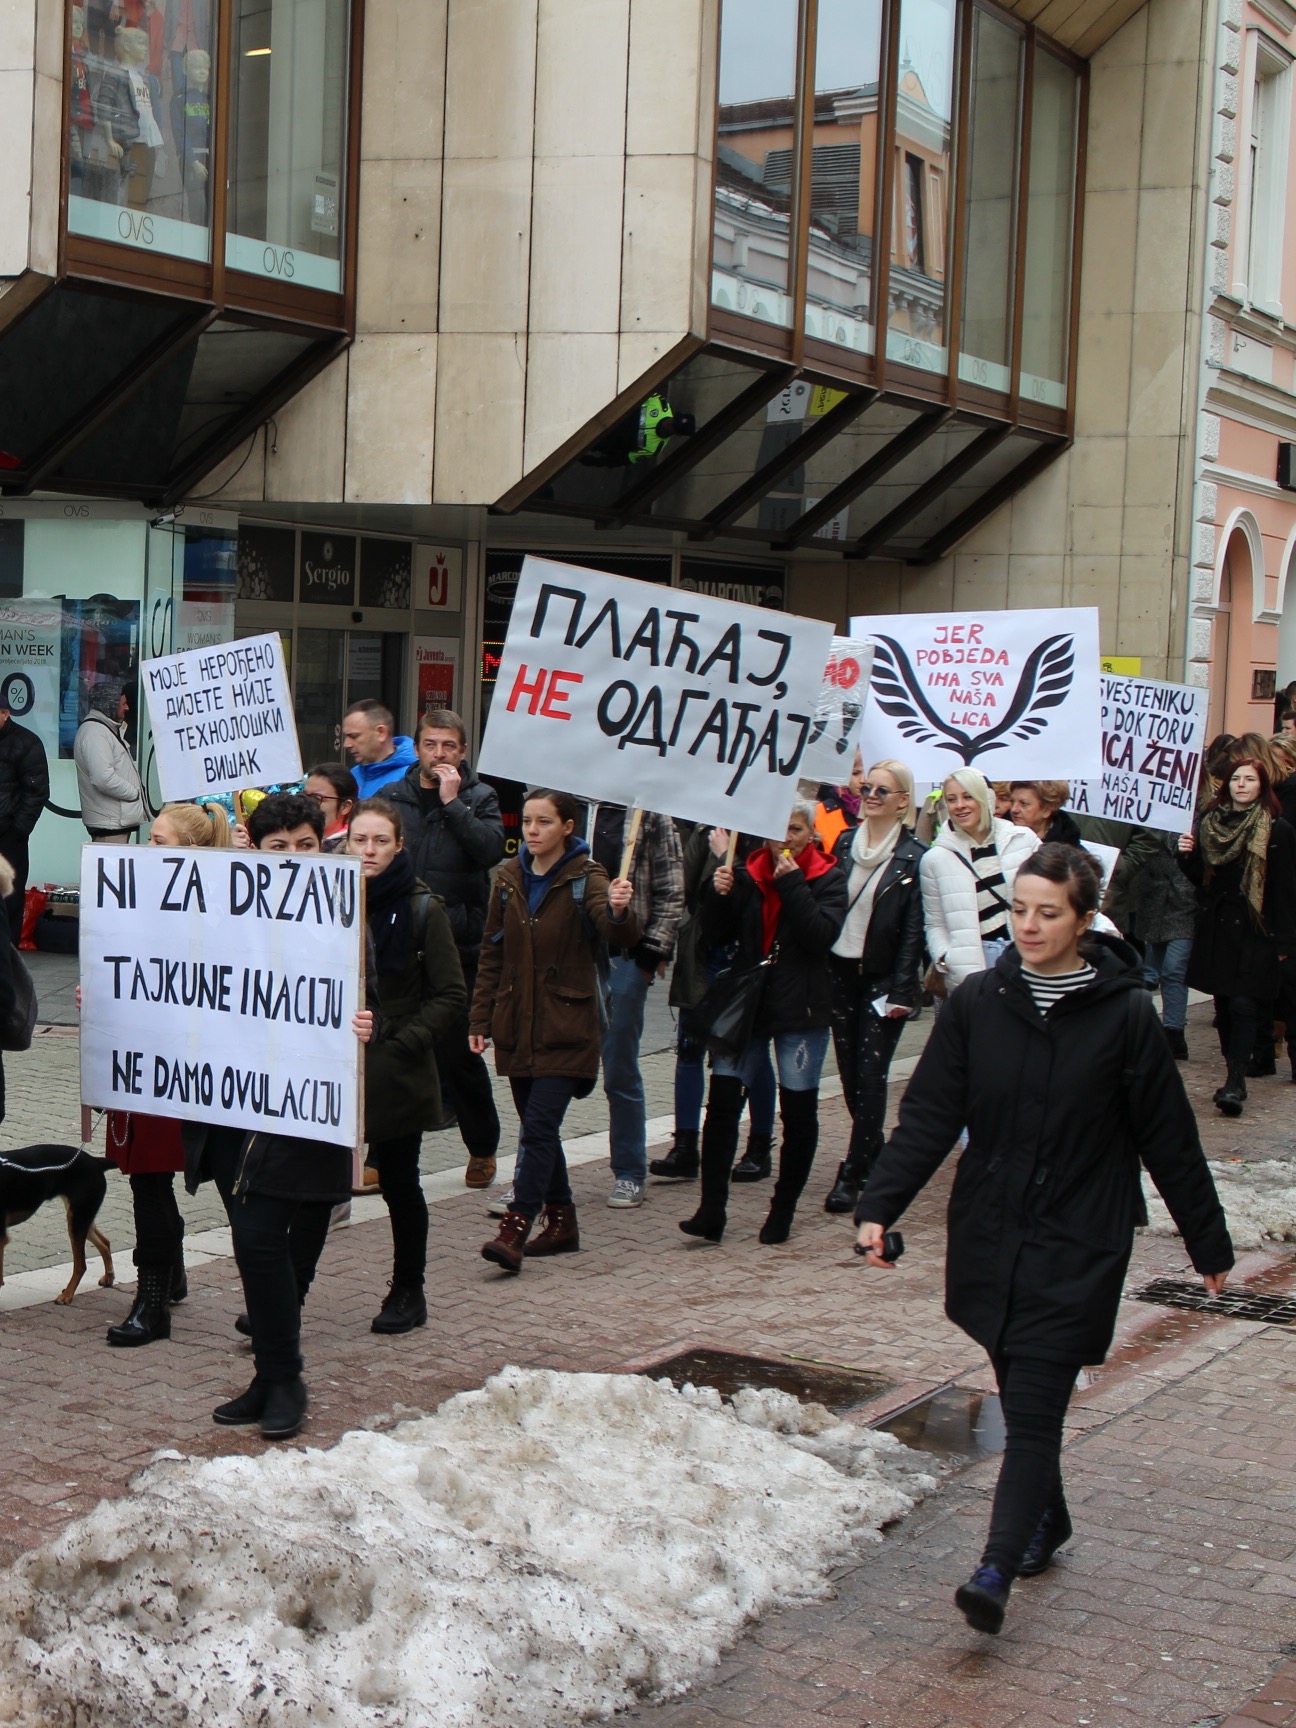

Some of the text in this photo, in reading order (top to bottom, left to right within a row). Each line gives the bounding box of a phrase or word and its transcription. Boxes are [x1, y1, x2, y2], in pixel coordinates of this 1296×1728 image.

[117, 210, 154, 245] OVS
[262, 246, 295, 278] OVS
[63, 505, 89, 518] OVS
[305, 560, 350, 591] Sergio
[933, 624, 984, 645] JER
[16, 645, 54, 656] WEEK
[916, 648, 1009, 667] POBJEDA
[149, 662, 188, 692] МОЈЕ
[506, 664, 584, 721] НЕ
[970, 670, 1004, 687] SVA
[949, 688, 996, 707] NAŠA
[950, 711, 991, 727] LICA
[1114, 707, 1194, 745] DOKTORU
[1138, 739, 1199, 791] ŽENI
[1101, 772, 1193, 812] NAŠA TIJELA
[1103, 793, 1152, 823] MIRU
[97, 857, 355, 928] NI ZA DRŽAVU
[103, 956, 233, 1012] TAJKUNE
[112, 1050, 342, 1127] NE DAMO OVULACIJU
